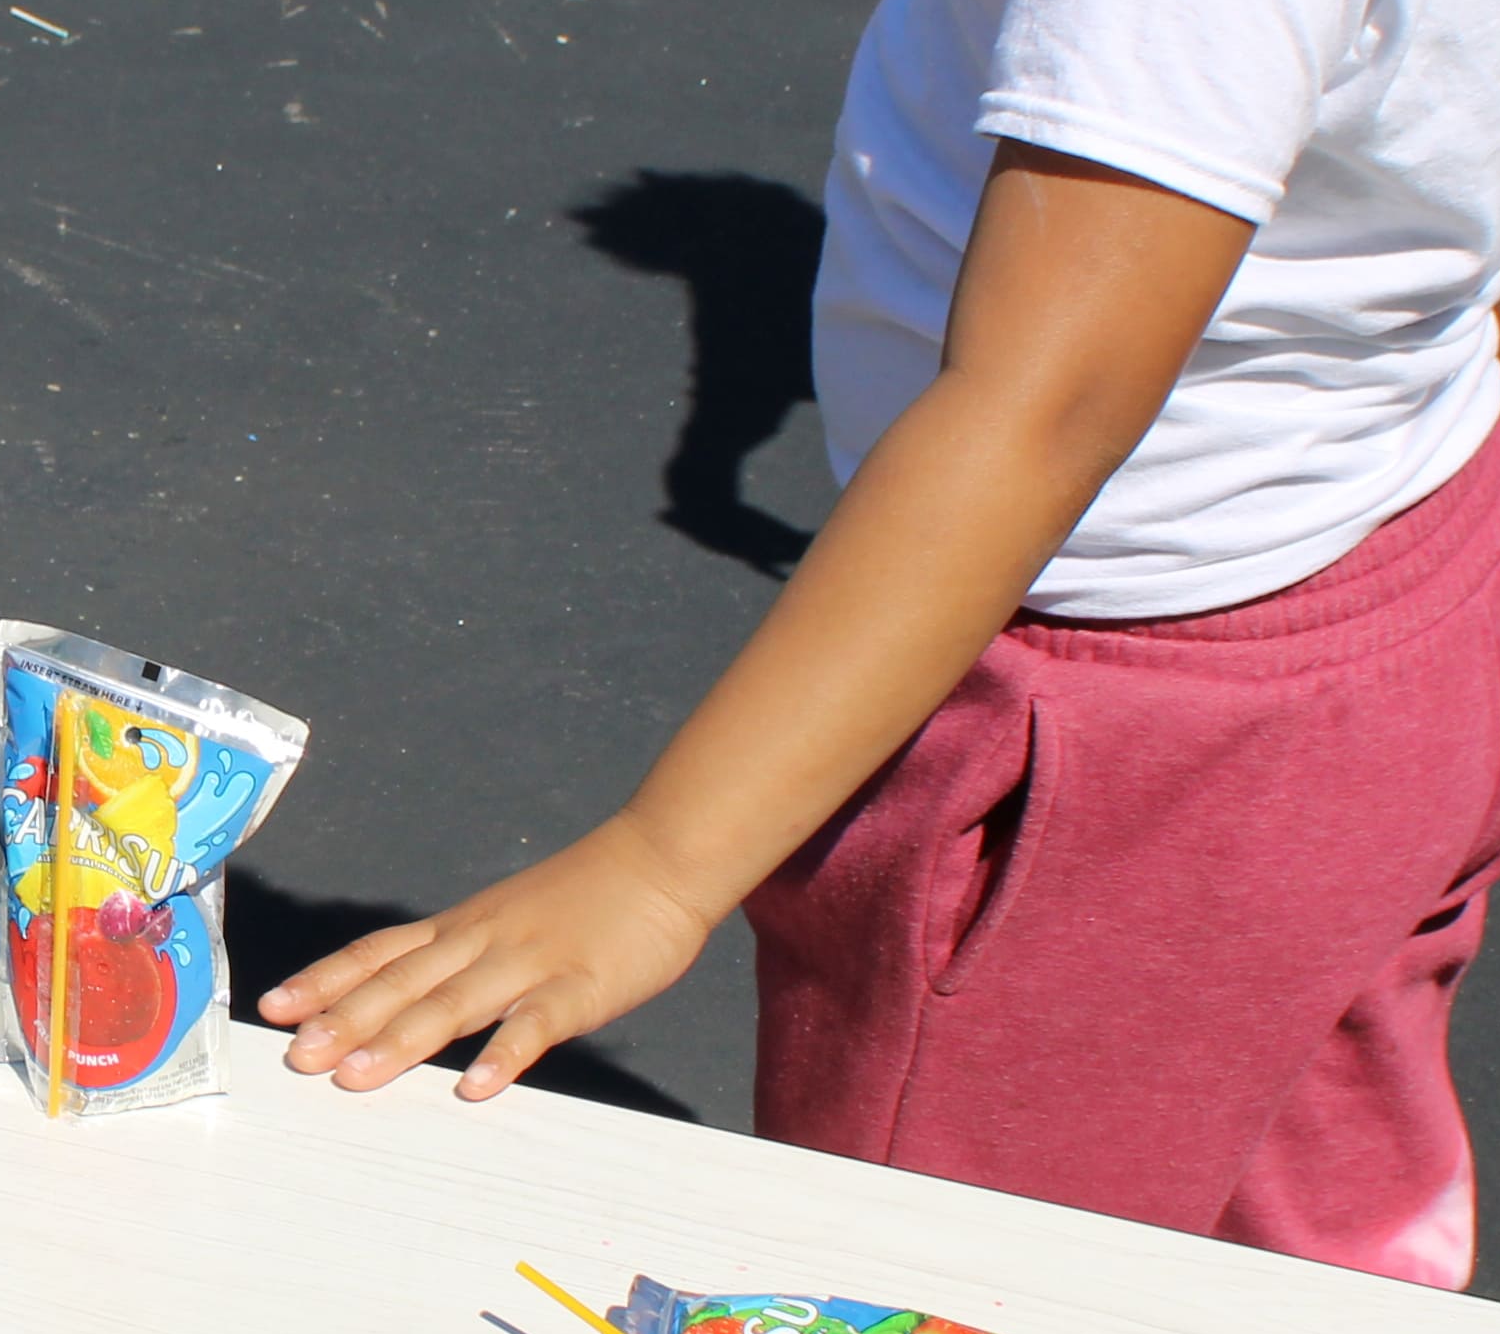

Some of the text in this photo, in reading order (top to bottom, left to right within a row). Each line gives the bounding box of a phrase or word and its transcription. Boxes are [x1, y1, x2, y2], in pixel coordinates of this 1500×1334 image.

[20, 659, 131, 708] INSERT STRAW HERE
[67, 1049, 120, 1067] PUNCH
